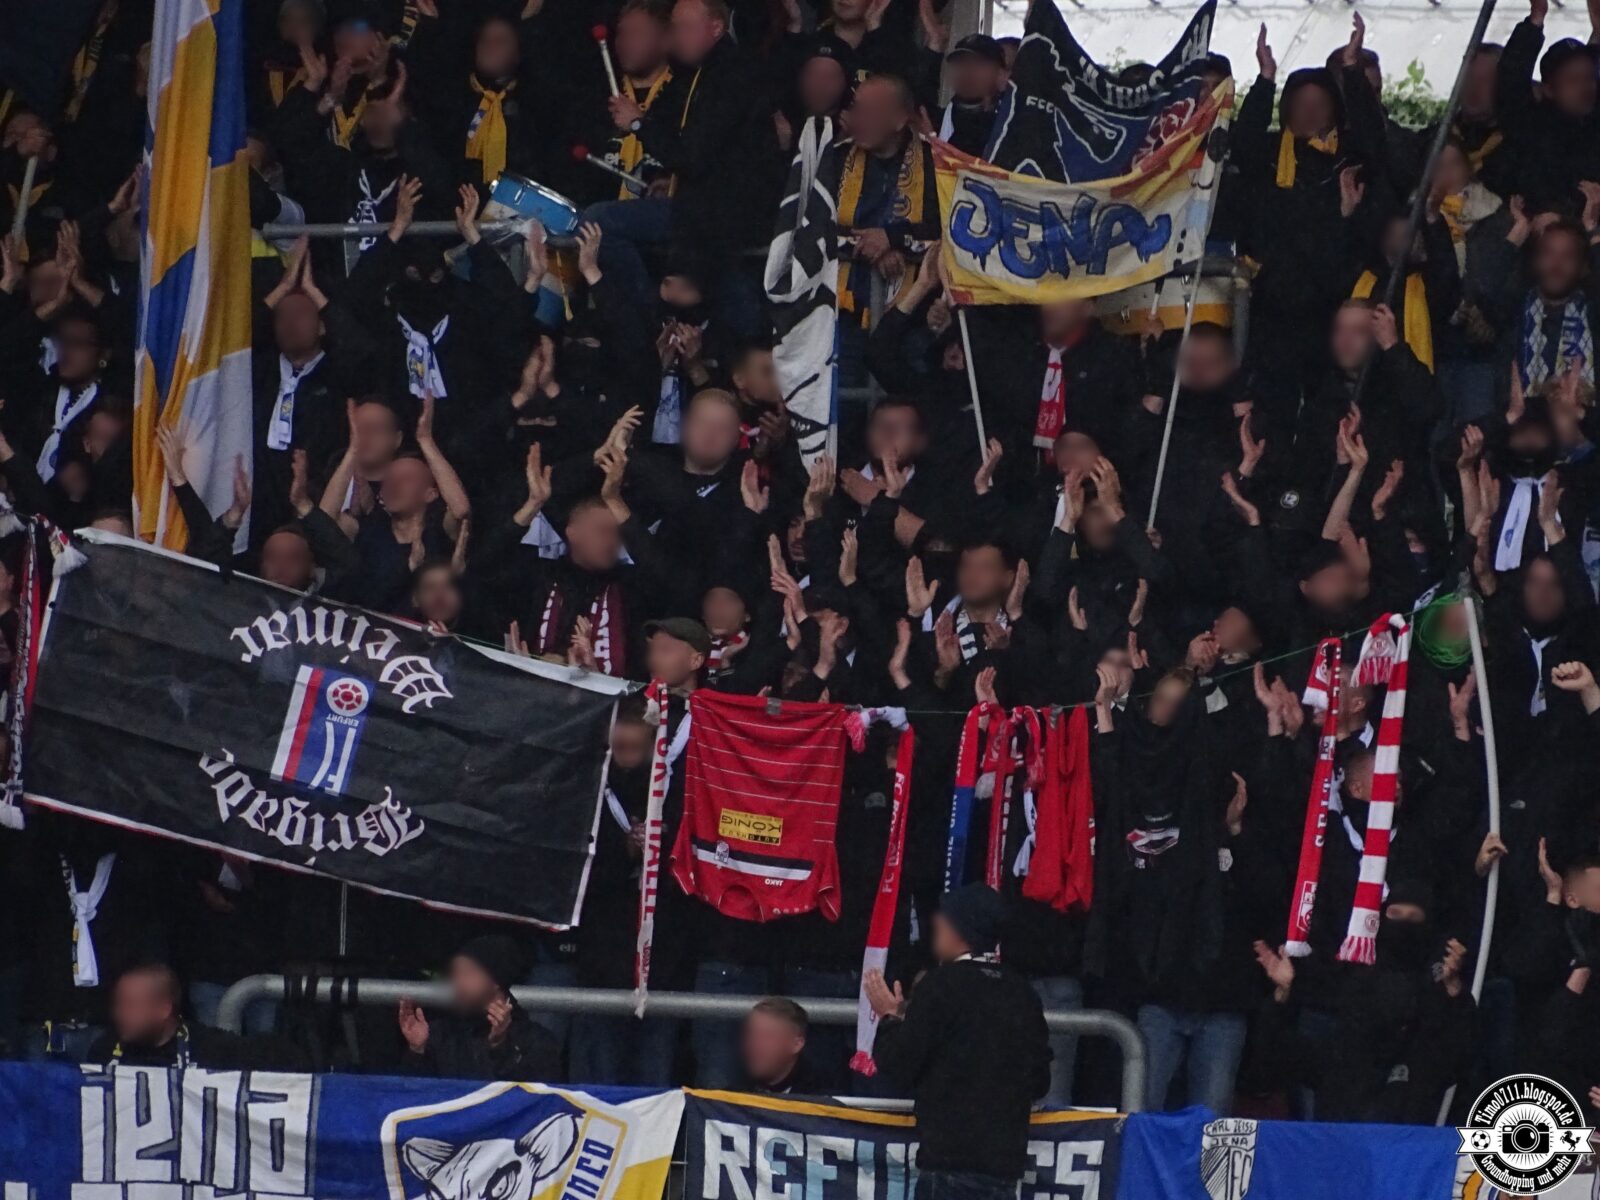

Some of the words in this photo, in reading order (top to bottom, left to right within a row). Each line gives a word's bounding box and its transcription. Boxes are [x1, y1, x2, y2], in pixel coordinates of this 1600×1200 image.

[950, 177, 1172, 280] JENA
[230, 606, 454, 714] Weimar
[325, 714, 360, 728] ERFURT
[198, 747, 425, 866] Brigade
[721, 814, 782, 834] KÖNIG
[764, 878, 784, 886] JAKO
[1206, 1121, 1230, 1134] CARL
[1233, 1119, 1254, 1133] ZEISS
[1211, 1137, 1249, 1147] JENA
[561, 1138, 614, 1200] NCO
[702, 1118, 1105, 1200] REFUS
